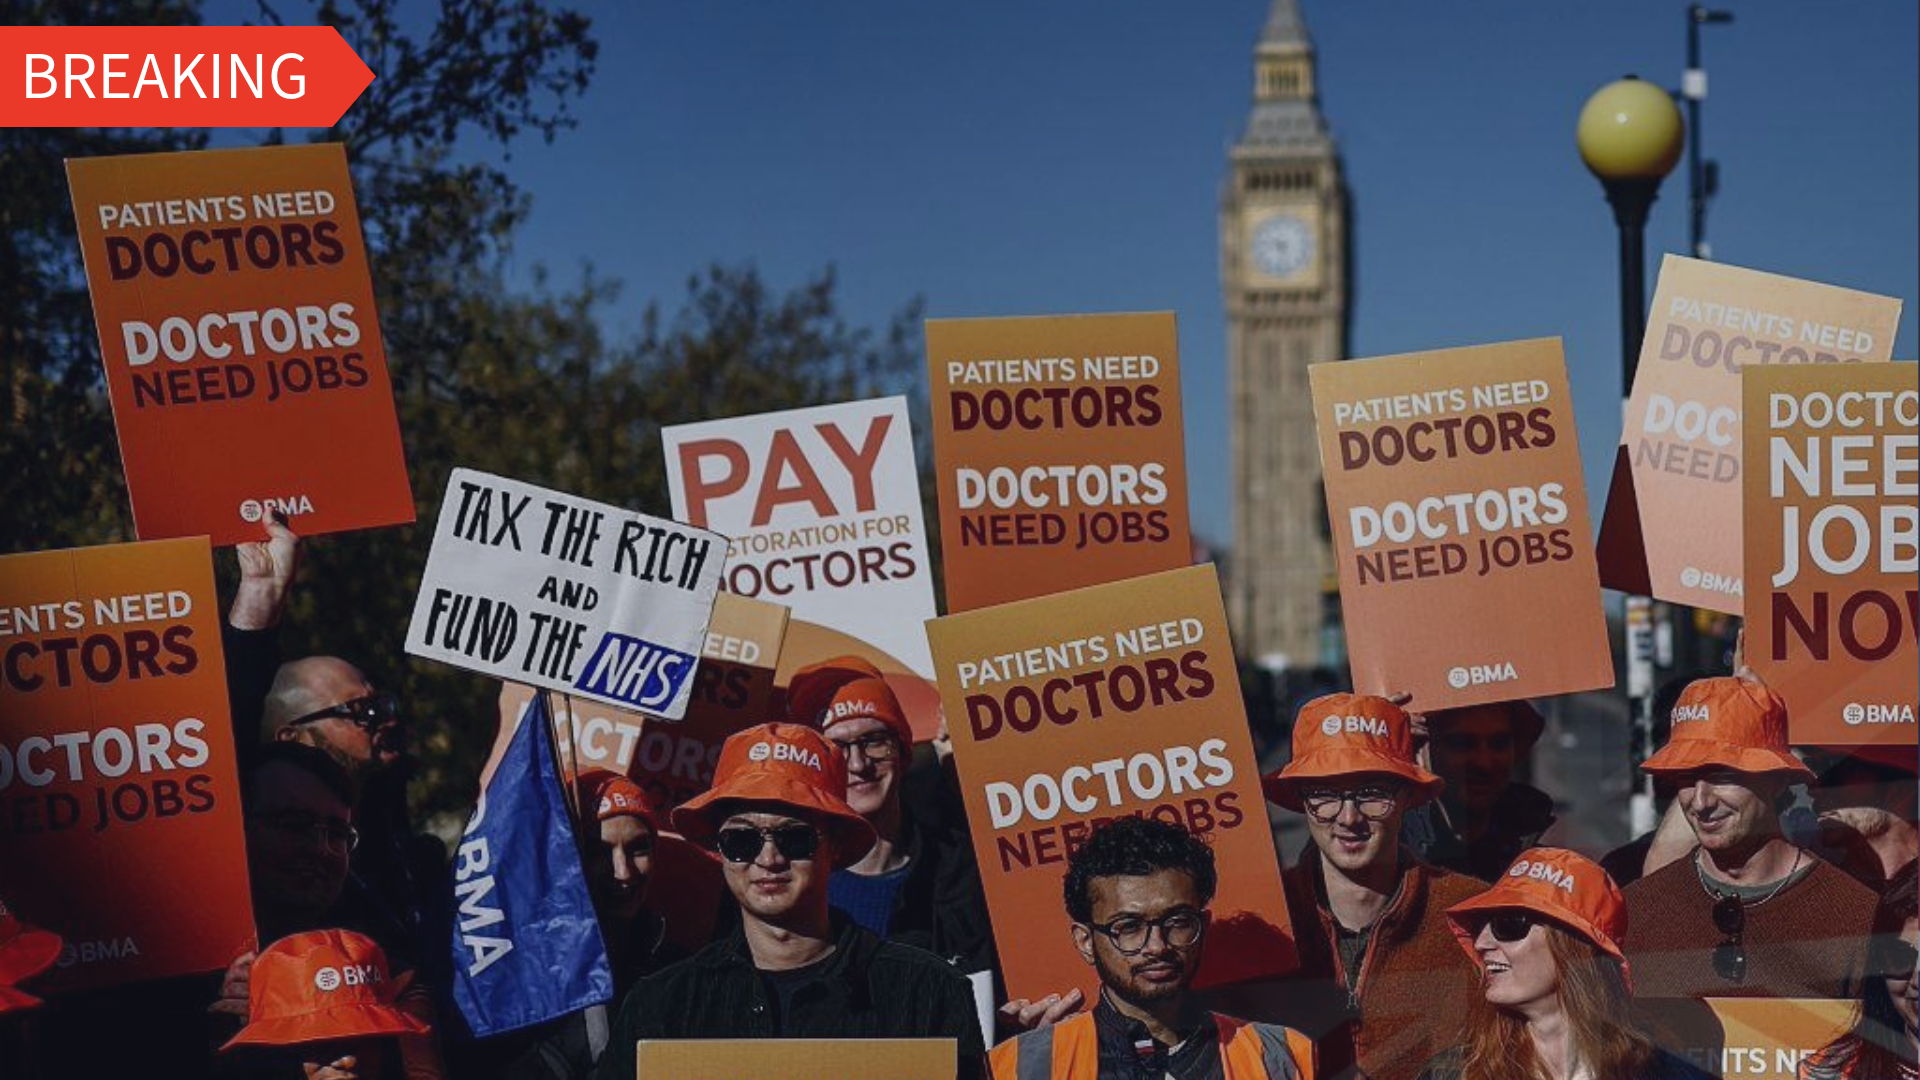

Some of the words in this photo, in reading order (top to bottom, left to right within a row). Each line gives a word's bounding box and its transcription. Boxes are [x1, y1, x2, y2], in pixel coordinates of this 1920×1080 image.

[99, 196, 246, 229] PATIENTS
[252, 190, 335, 219] NEED
[105, 221, 344, 280] DOCTORS
[121, 302, 361, 366] DOCTORS
[1659, 324, 1864, 374] DOCT
[1669, 296, 1793, 340] PATIENTS
[1799, 320, 1874, 353] NEED
[132, 364, 256, 408] NEED
[267, 353, 369, 401] JOBS
[947, 357, 1077, 385] PATIENTS
[1083, 356, 1160, 380] NEED
[951, 384, 1162, 431] DOCTORS
[1333, 389, 1467, 427] PATIENTS
[1472, 380, 1550, 409] NEED
[1644, 393, 1742, 447] DOC
[1339, 407, 1556, 471] DOCTORS
[1634, 440, 1740, 485] NEED
[678, 415, 894, 529] PAY
[956, 463, 1168, 509] DOCTORS
[453, 482, 531, 551] TAX
[541, 501, 604, 567] THE
[613, 521, 710, 590] RICH
[863, 515, 910, 538] FOR
[961, 514, 1066, 546] NEED
[1075, 510, 1170, 550] JOBS
[1349, 482, 1568, 548] DOCTORS
[719, 542, 916, 597] OCTORS
[1356, 543, 1468, 585] NEED
[1477, 529, 1574, 577] JOBS
[93, 590, 192, 625] NEED
[538, 576, 598, 610] AND
[1700, 571, 1744, 596] BMA
[424, 588, 518, 664] FUND
[522, 612, 587, 683] THE
[587, 637, 682, 706] NHS
[1771, 590, 1918, 661] NO
[957, 636, 1109, 689] PATIENTS
[1115, 618, 1204, 657] NEED
[1469, 662, 1518, 685] BMA
[834, 699, 876, 717] BMA
[965, 650, 1215, 741] DOCTORS
[1676, 703, 1709, 722] BMA
[1867, 704, 1915, 723] BMA
[1344, 715, 1389, 737] BMA
[773, 742, 822, 771] BMA
[94, 774, 215, 832] JOBS
[985, 738, 1234, 829] DOCTORS
[997, 815, 1117, 872] NEE
[1528, 862, 1574, 893] BMA
[455, 837, 514, 978] BMA
[82, 937, 140, 962] BMA
